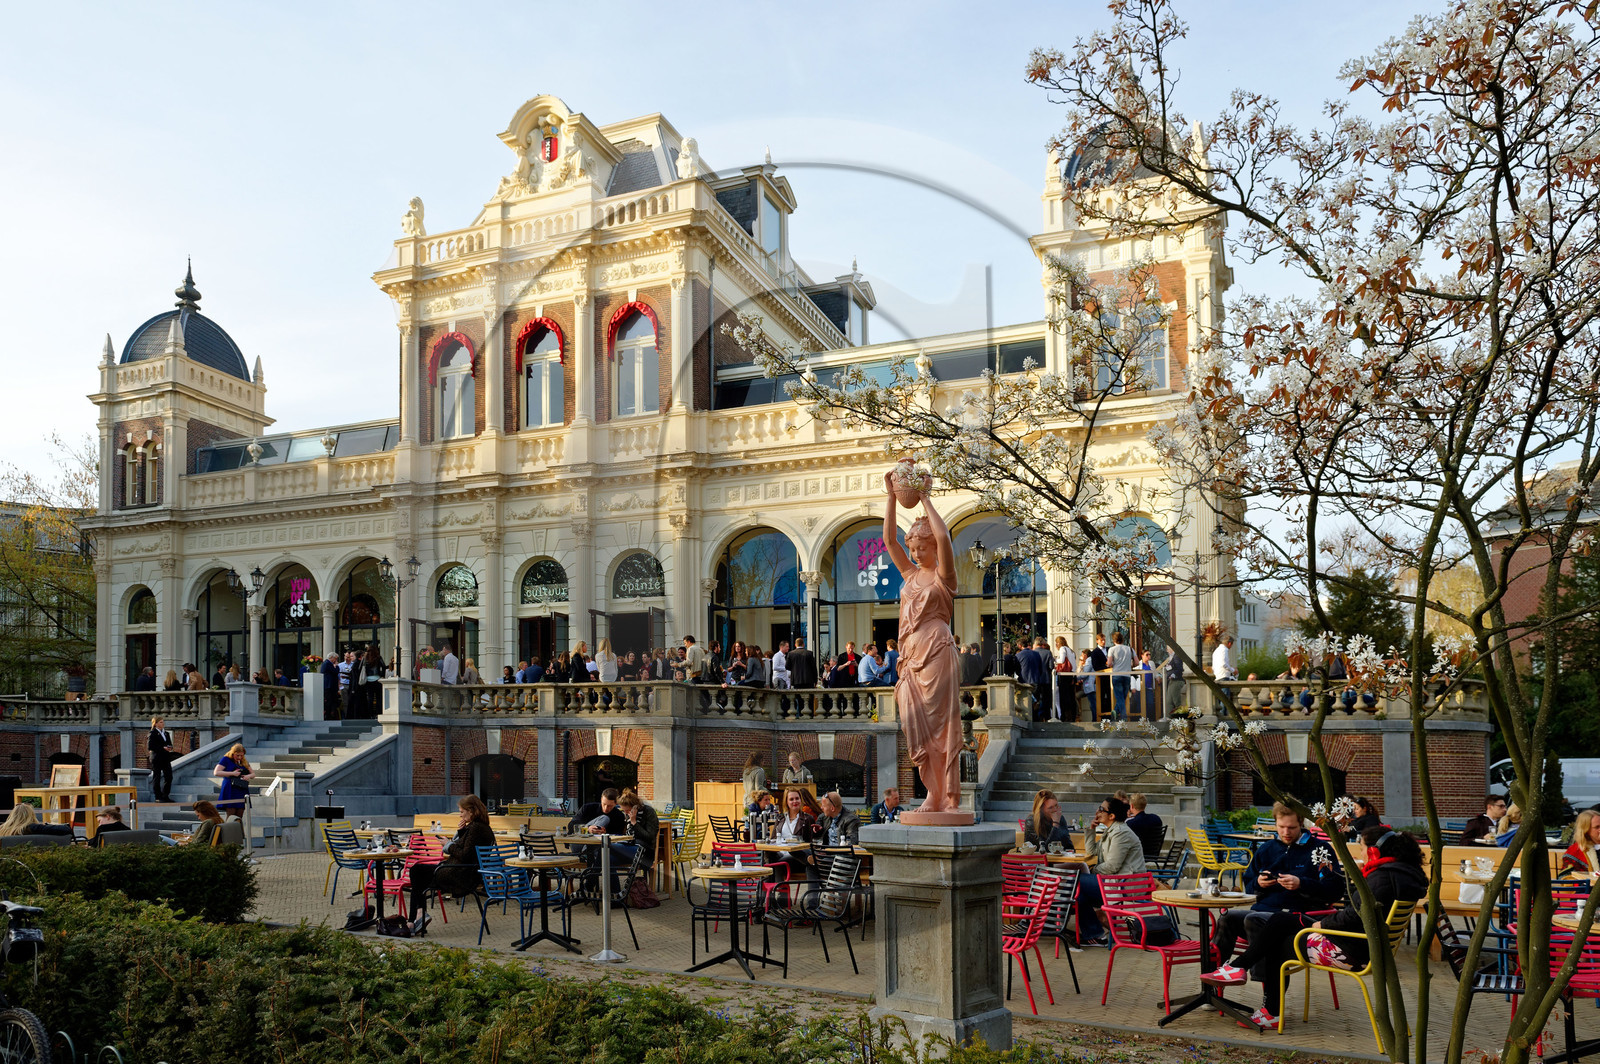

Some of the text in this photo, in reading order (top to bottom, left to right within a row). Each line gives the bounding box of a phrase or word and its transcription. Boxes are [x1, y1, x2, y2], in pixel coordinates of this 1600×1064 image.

[857, 538, 888, 554] VON
[290, 578, 310, 591] VON
[525, 586, 568, 597] cultuur
[620, 577, 661, 594] opinie
